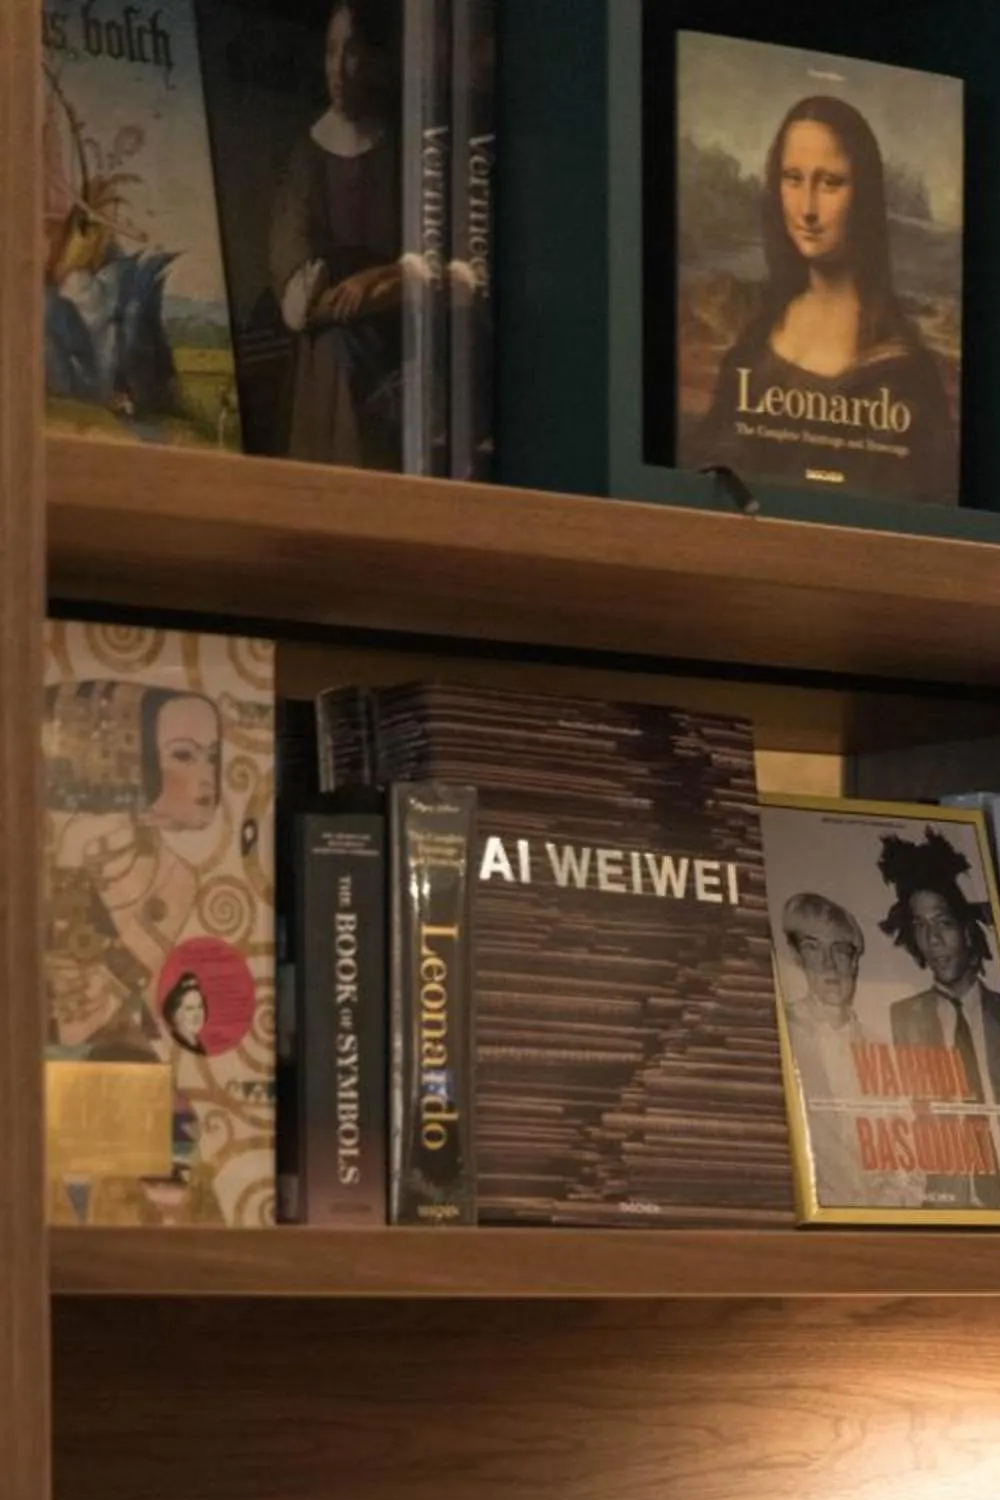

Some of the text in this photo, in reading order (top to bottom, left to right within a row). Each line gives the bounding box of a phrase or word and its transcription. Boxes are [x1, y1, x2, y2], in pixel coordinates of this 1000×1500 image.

[736, 367, 912, 433] Leonardo
[478, 836, 532, 885] AI
[545, 842, 739, 905] WEIWEI
[335, 912, 358, 1003] BOOK
[420, 922, 460, 1151] Leonardo
[336, 1033, 360, 1185] SYMBOLS
